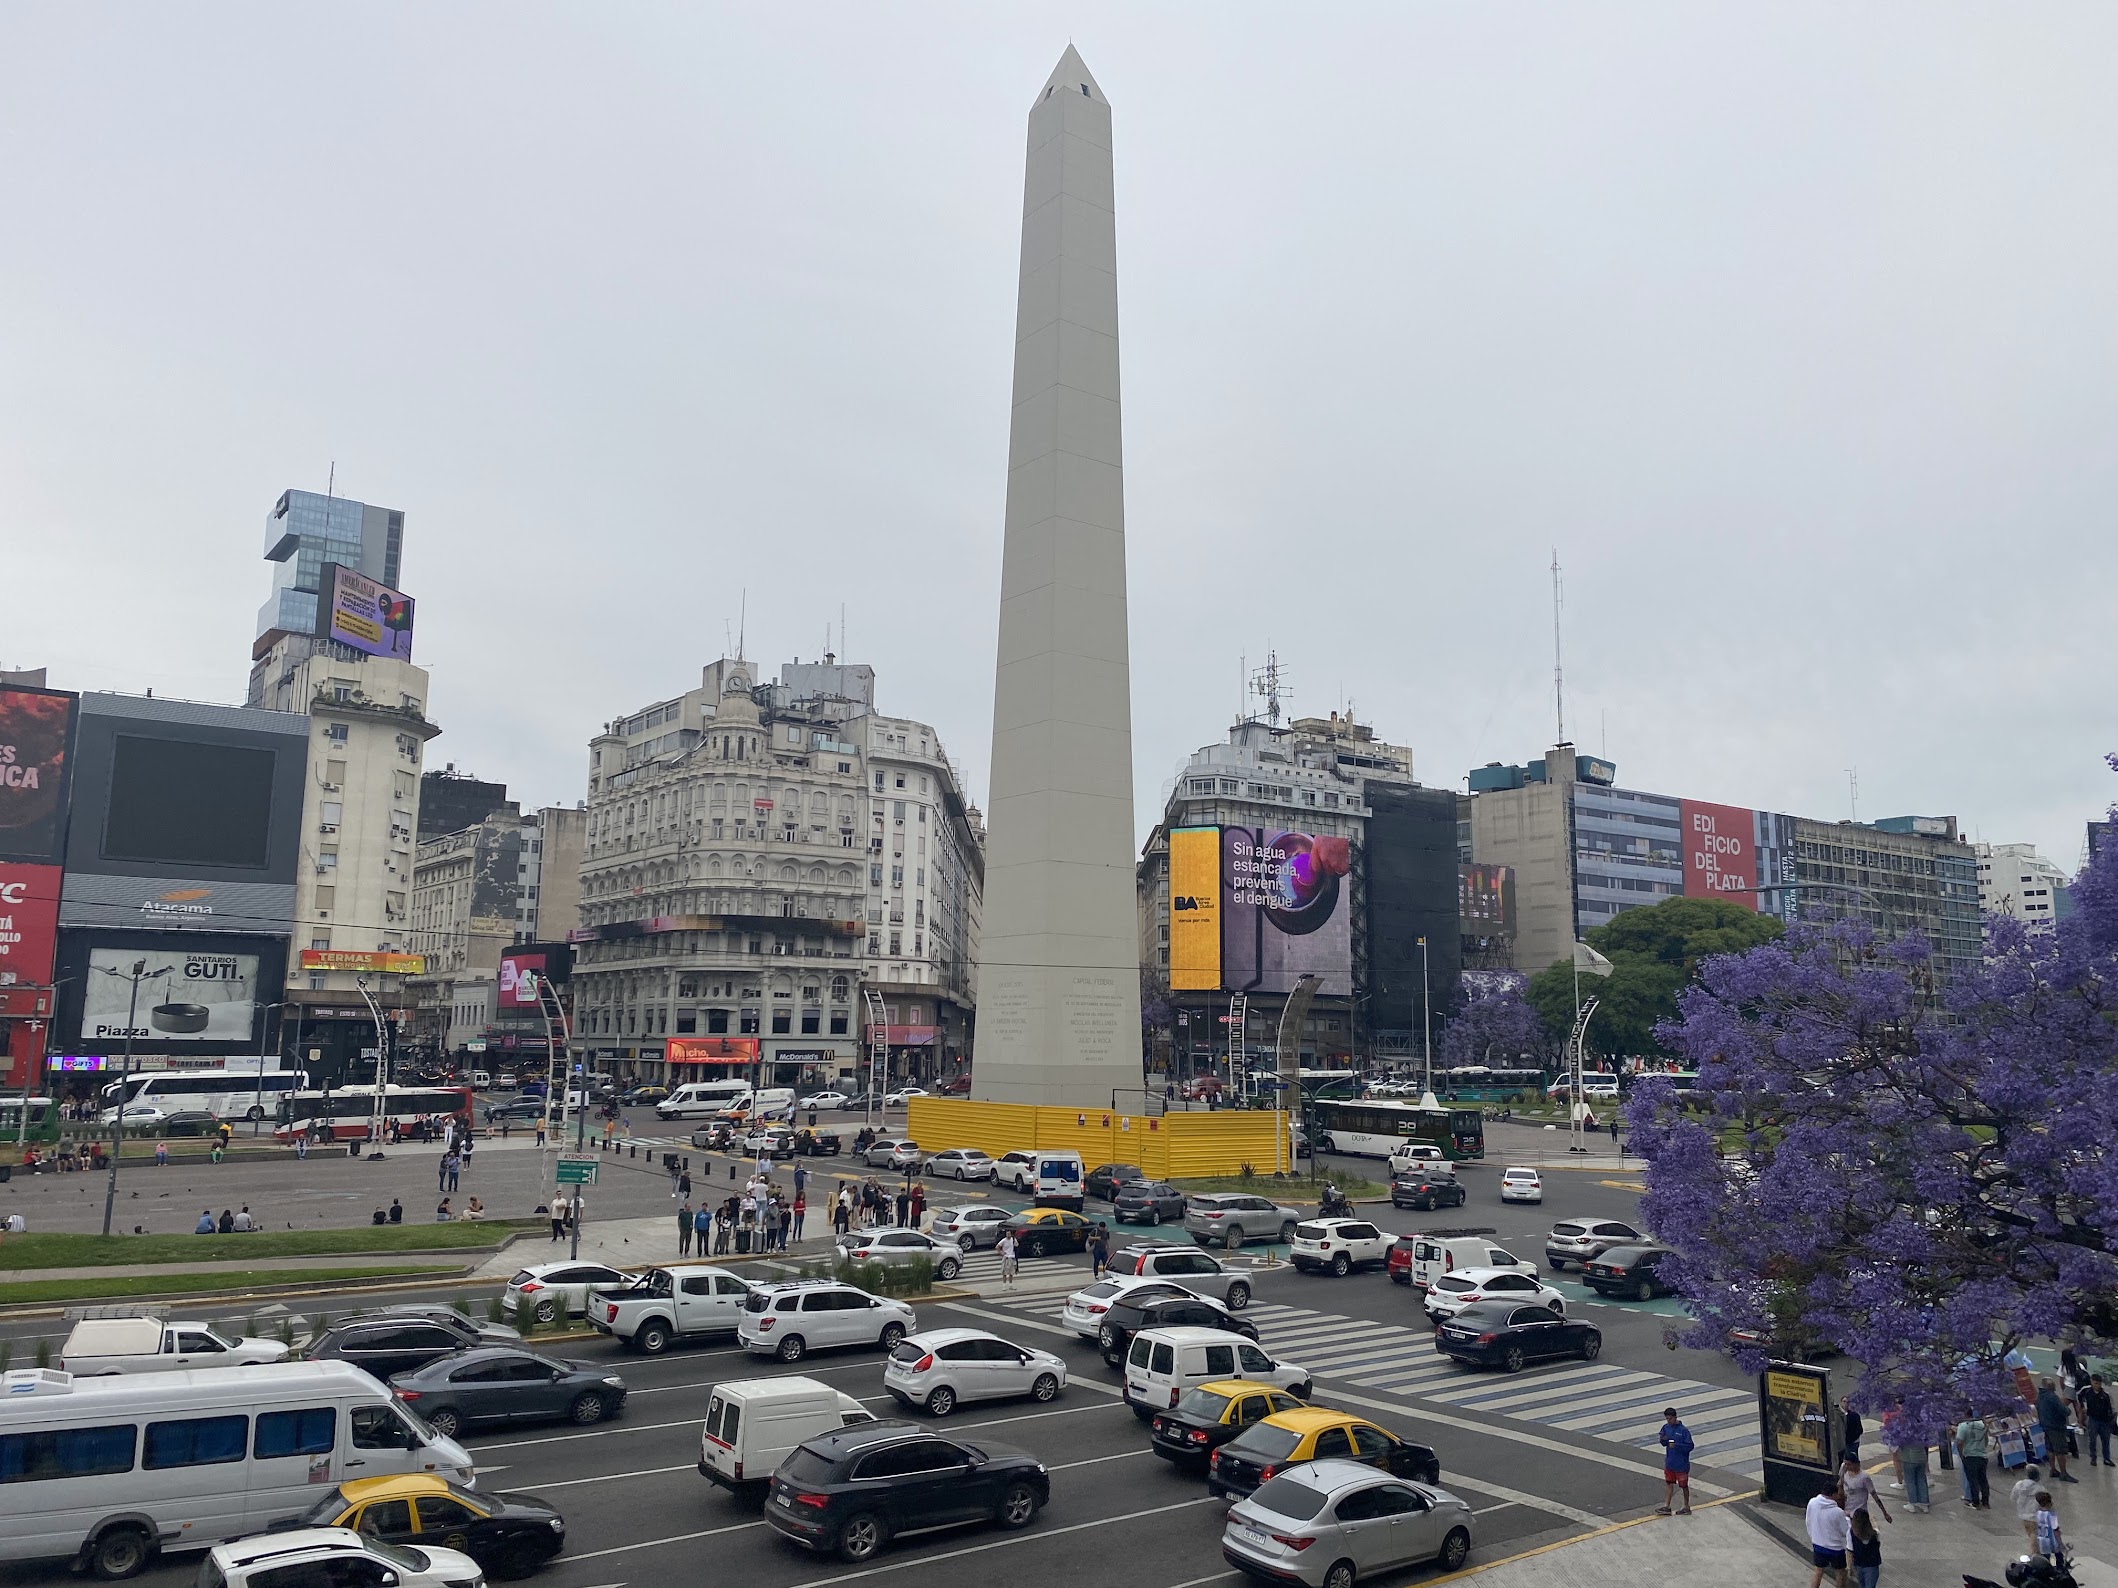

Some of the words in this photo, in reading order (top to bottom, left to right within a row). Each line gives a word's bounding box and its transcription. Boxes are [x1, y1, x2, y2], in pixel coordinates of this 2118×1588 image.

[1693, 813, 1716, 833] EDI
[1233, 842, 1253, 856] Sin
[1255, 846, 1286, 861] agua
[1704, 834, 1741, 855] FICIO
[1695, 851, 1721, 871] DEL
[1233, 860, 1300, 879] estancada,
[1233, 876, 1286, 892] prevenís
[1706, 872, 1747, 893] PLATA
[0, 882, 26, 903] C
[1233, 890, 1245, 903] el
[1246, 891, 1293, 909] dengue
[140, 901, 213, 914] Atacama
[1174, 896, 1198, 910] BA
[186, 955, 237, 963] SANITARIOS
[319, 953, 373, 962] TERMAS
[184, 963, 244, 979] GUTI.
[96, 1024, 149, 1036] Piazza
[672, 1042, 709, 1058] Mucho,
[1773, 1375, 1790, 1383] Juntos
[1791, 1378, 1815, 1387] estamos
[1773, 1382, 1814, 1393] transformando
